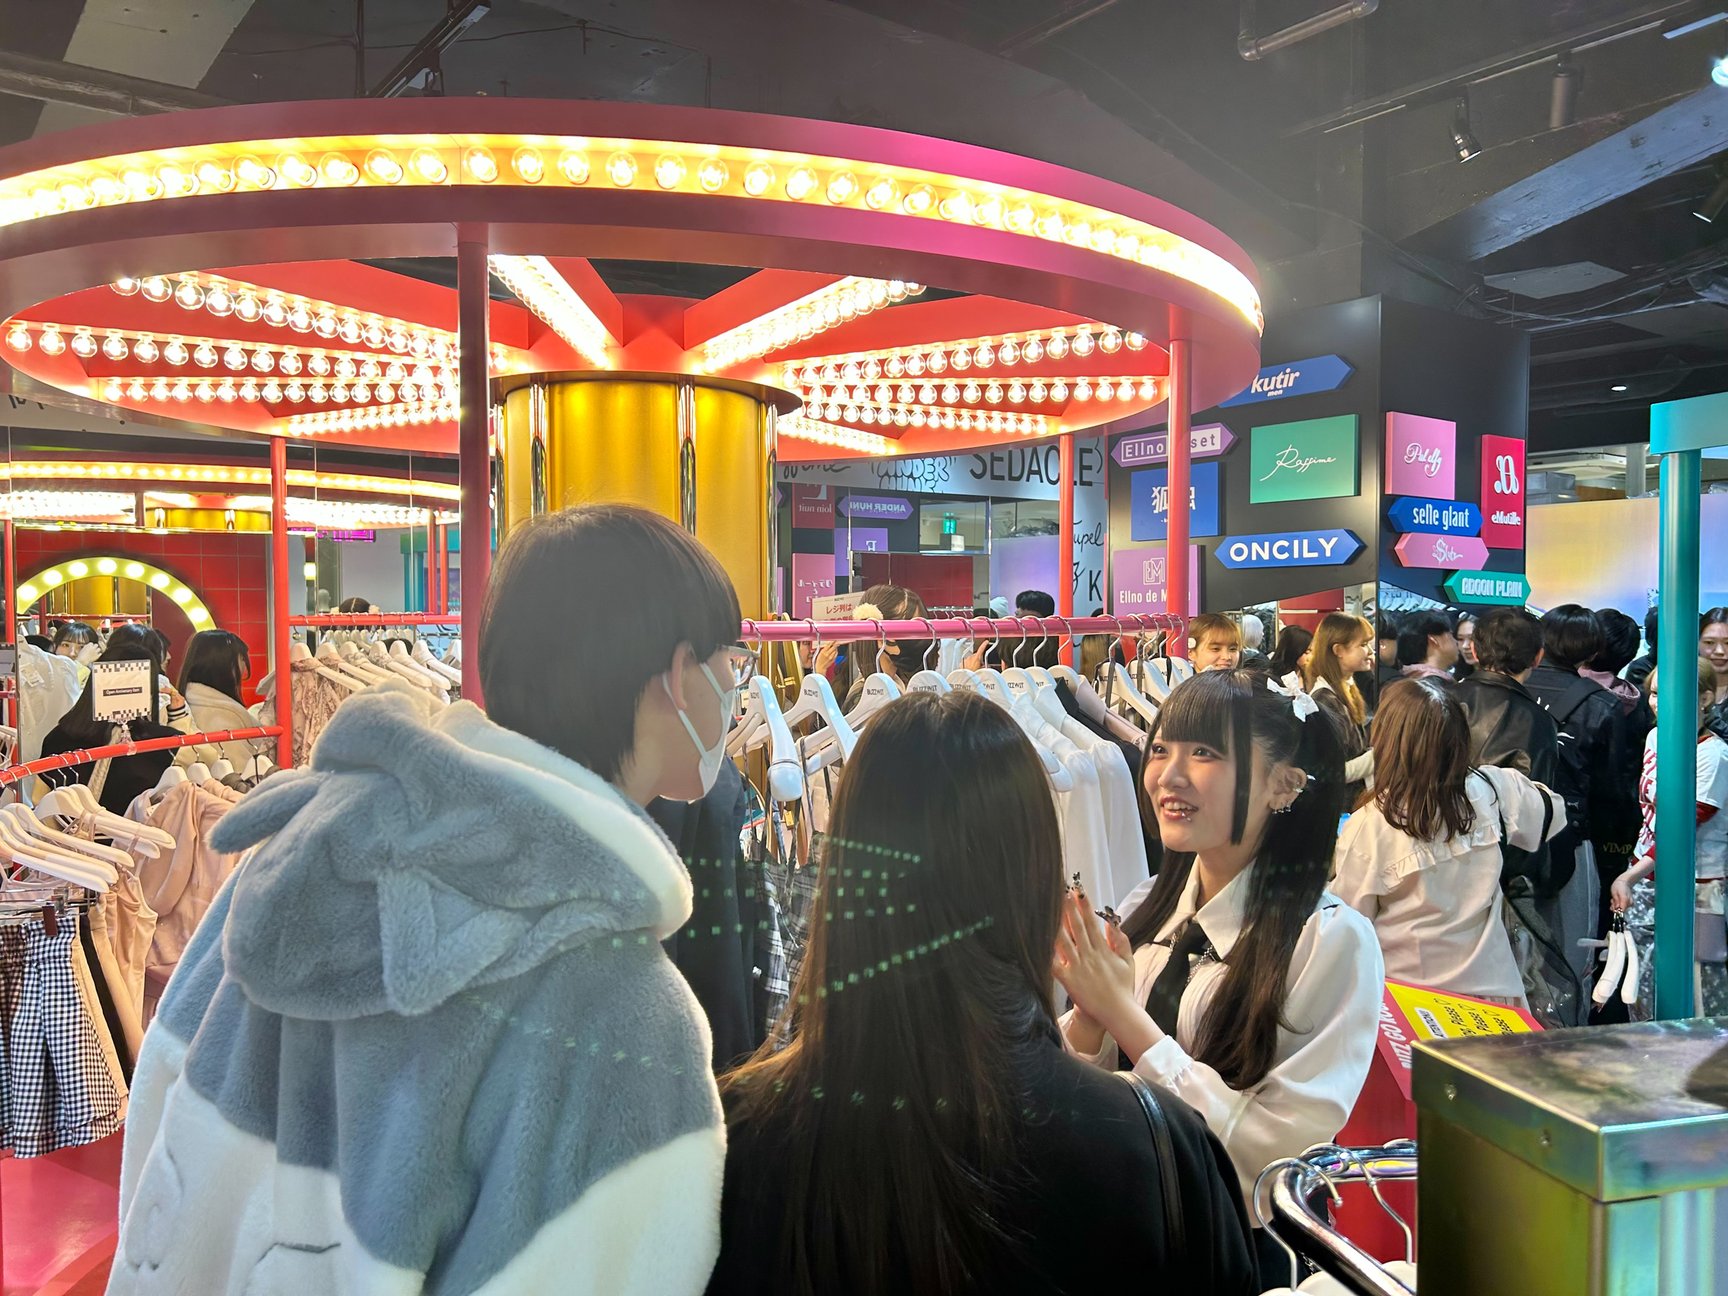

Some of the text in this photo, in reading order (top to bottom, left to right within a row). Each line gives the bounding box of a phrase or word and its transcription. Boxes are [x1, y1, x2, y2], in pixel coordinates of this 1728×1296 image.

[1250, 367, 1300, 394] kutir
[1412, 503, 1439, 525] selle
[1229, 536, 1339, 562] ONCILY
[1146, 589, 1158, 603] de
